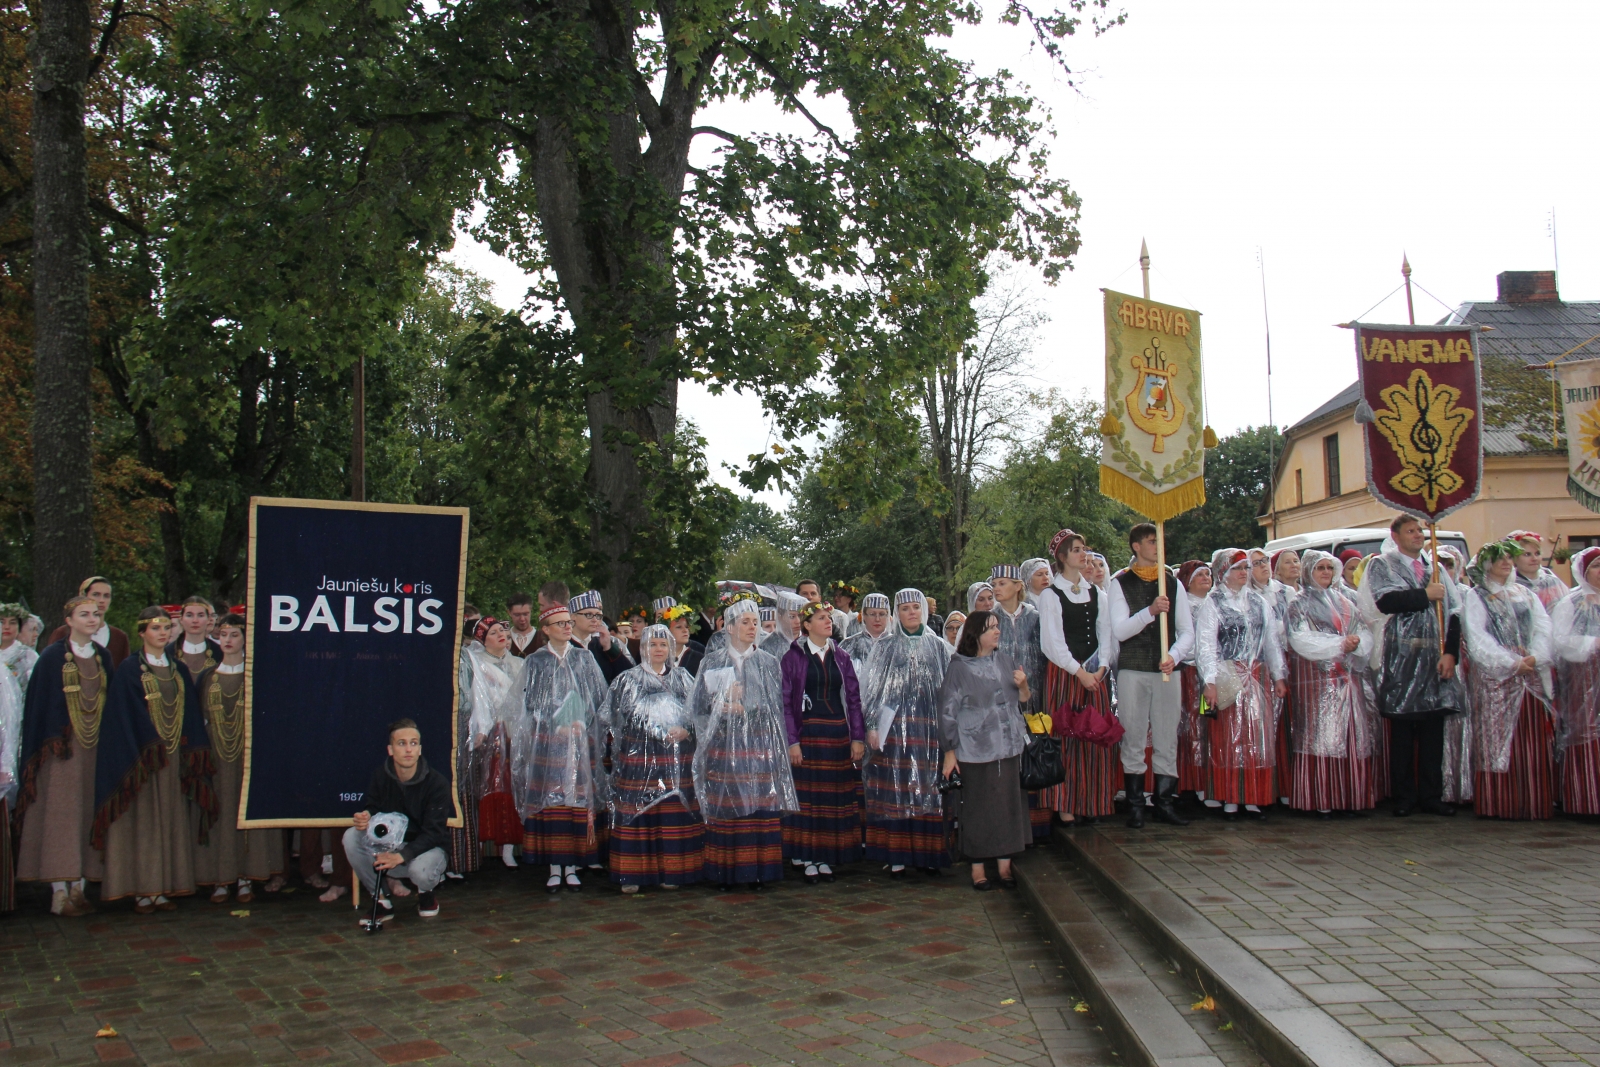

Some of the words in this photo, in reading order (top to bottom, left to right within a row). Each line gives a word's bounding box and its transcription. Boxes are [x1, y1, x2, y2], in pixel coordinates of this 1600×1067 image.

[1118, 300, 1191, 337] ABAVA
[1361, 336, 1475, 363] VANEMA
[316, 575, 389, 593] Jauniešu
[394, 577, 432, 594] koris
[269, 594, 444, 635] BALSIS
[339, 792, 364, 802] 1987
